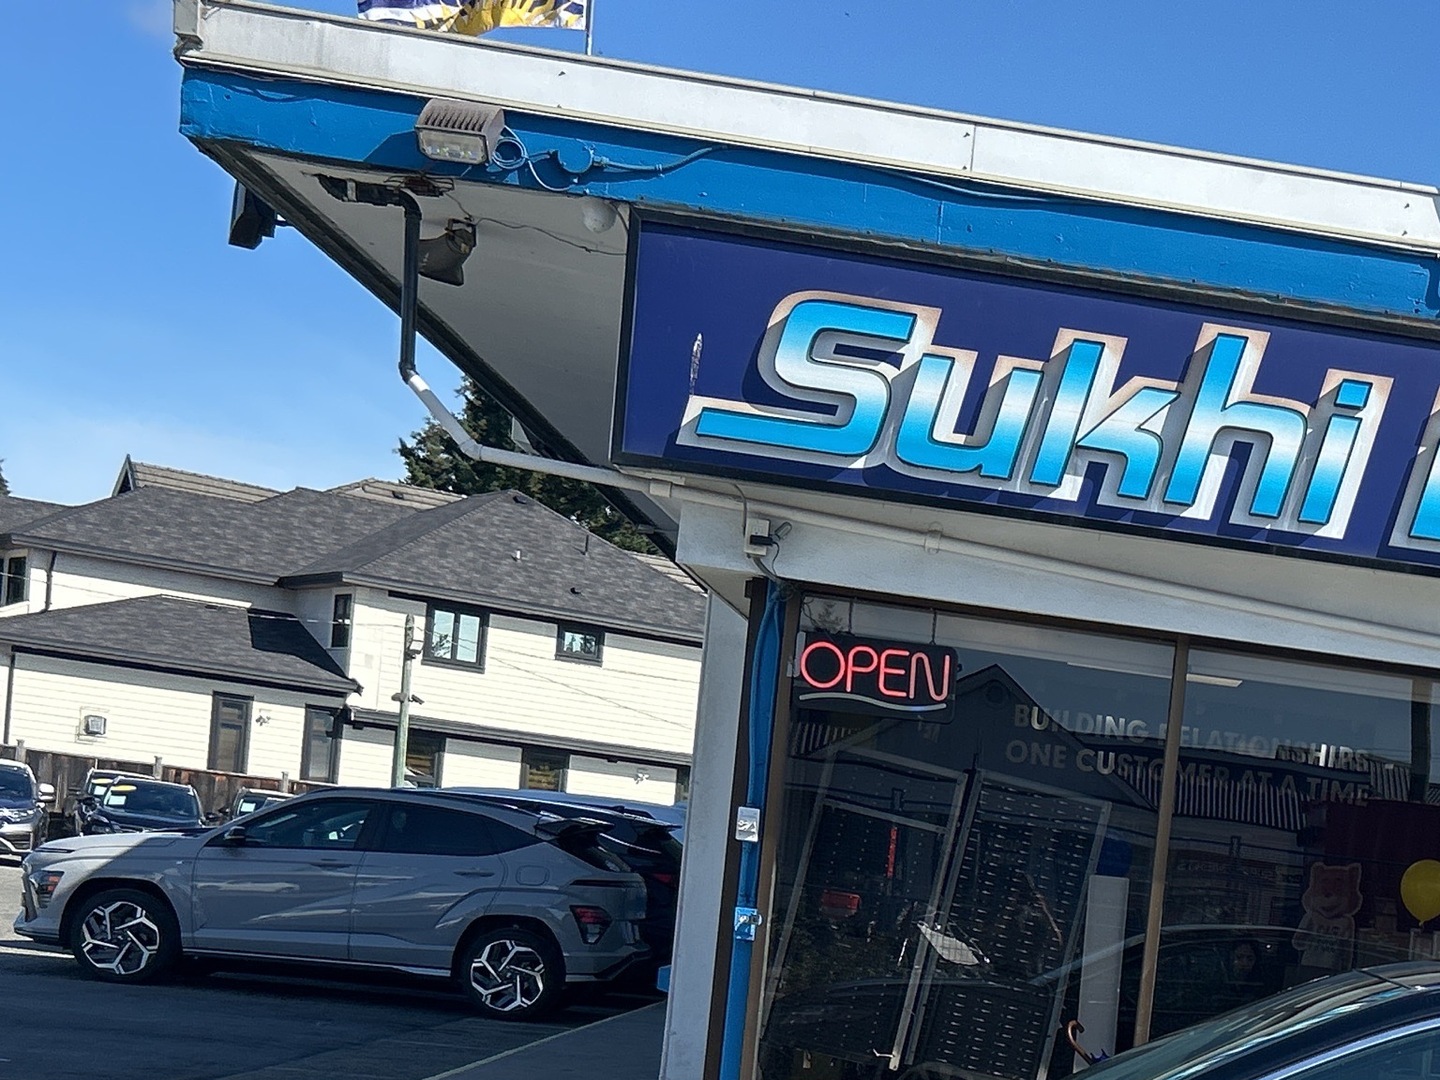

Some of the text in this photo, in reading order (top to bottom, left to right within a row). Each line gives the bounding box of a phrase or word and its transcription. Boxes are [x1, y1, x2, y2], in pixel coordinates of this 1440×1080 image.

[677, 290, 1394, 540] Sukhi
[800, 641, 950, 701] OPEN
[1014, 704, 1149, 743] BUILDING
[1006, 740, 1067, 768] ONE
[1305, 777, 1370, 807] TIME
